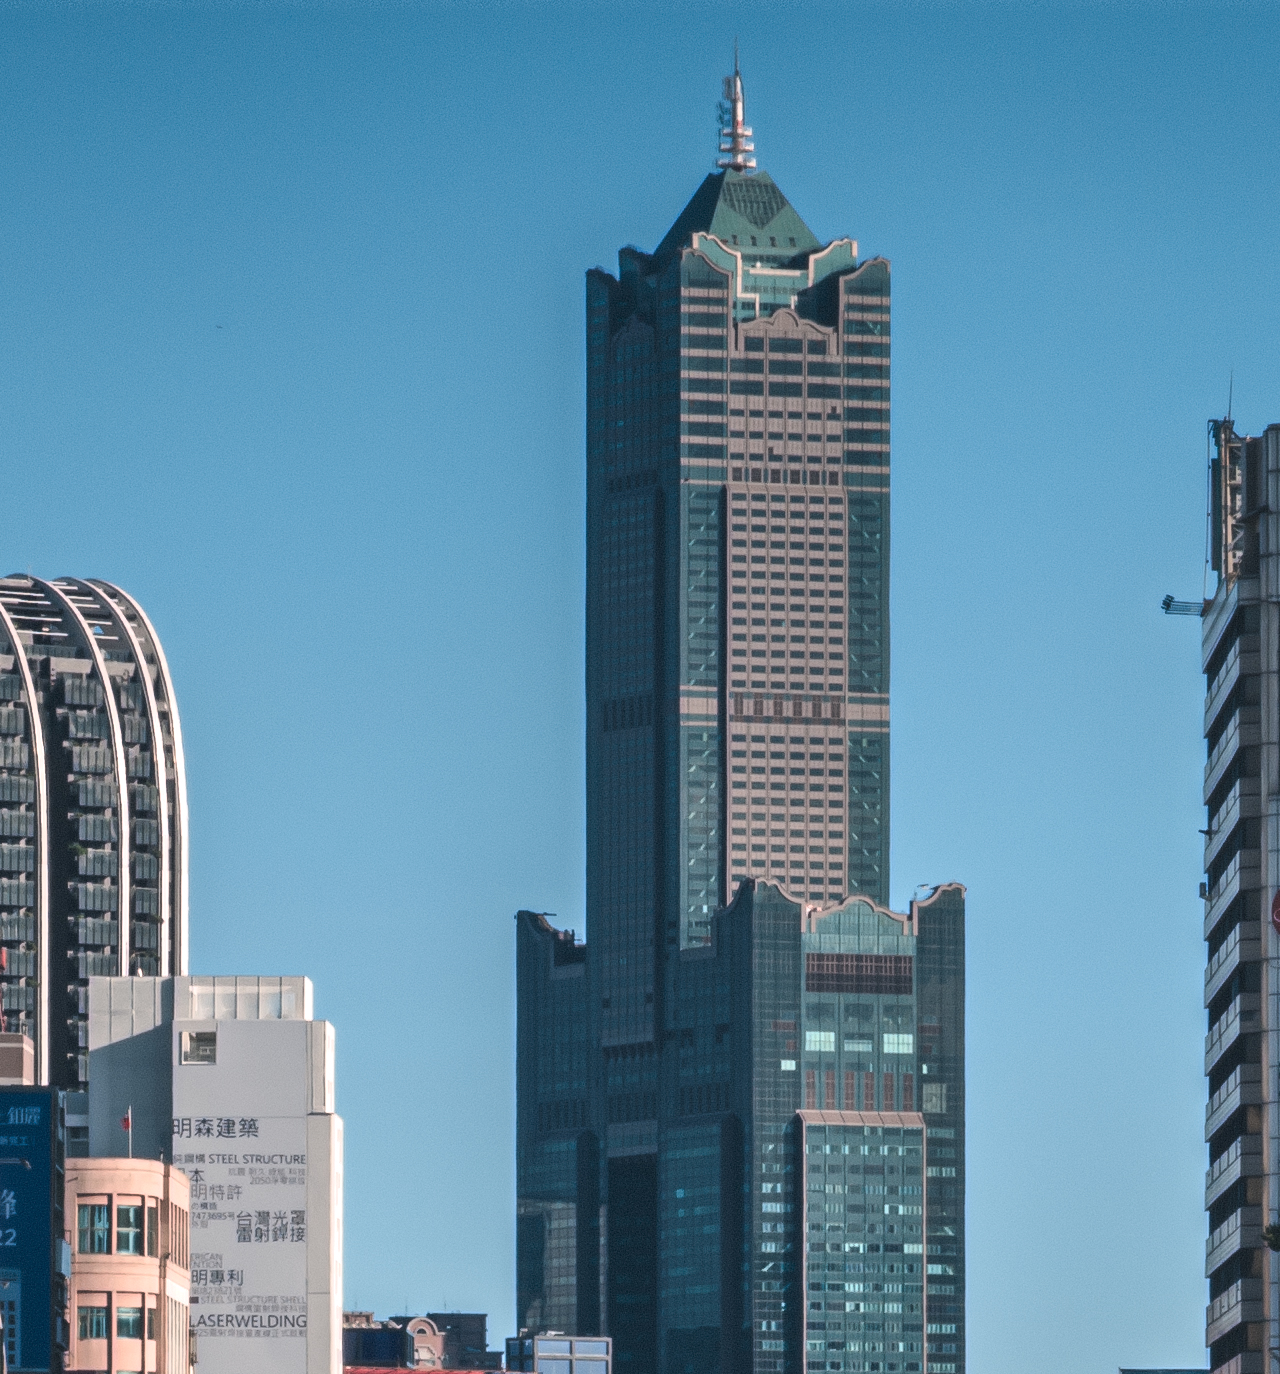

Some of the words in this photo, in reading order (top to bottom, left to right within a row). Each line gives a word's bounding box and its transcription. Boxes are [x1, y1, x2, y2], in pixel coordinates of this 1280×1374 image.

[173, 1117, 259, 1139] 明森建築
[208, 1153, 240, 1165] STEEL
[242, 1153, 307, 1165] STRUCTURE
